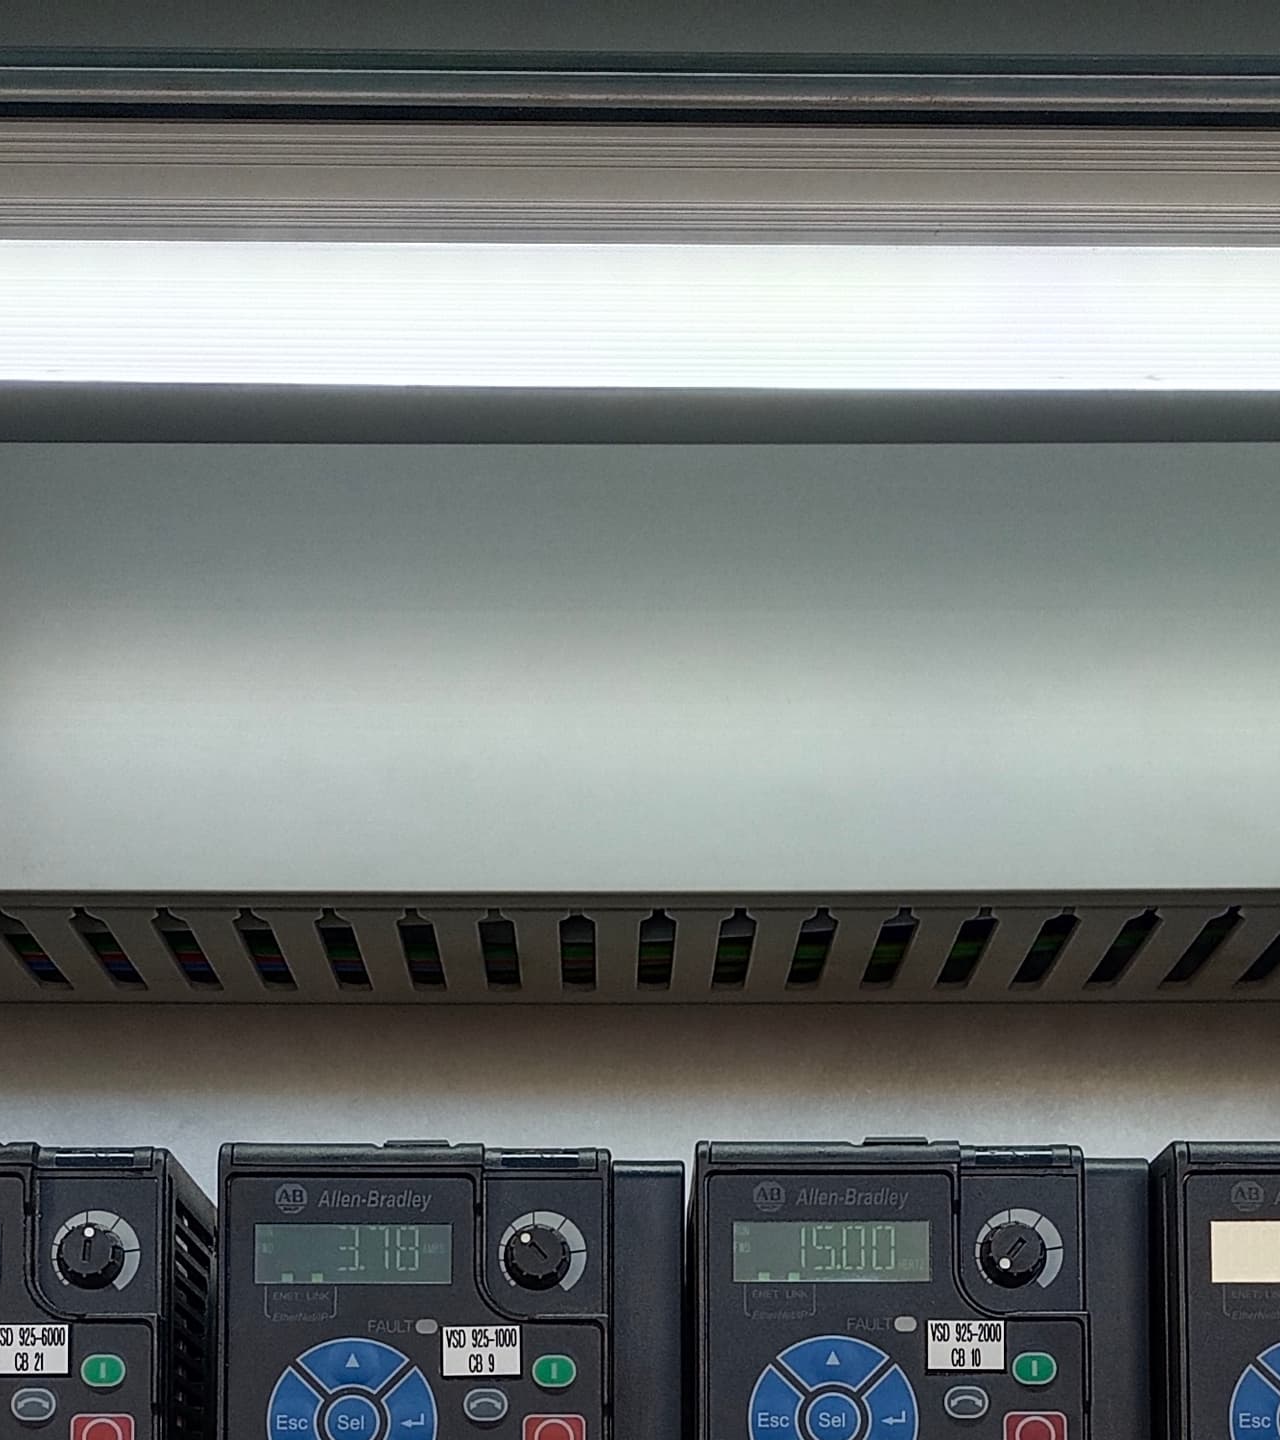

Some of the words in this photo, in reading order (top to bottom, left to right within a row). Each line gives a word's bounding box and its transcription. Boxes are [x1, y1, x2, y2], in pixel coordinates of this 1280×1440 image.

[318, 1190, 431, 1212] Allen-Bradley
[796, 1188, 909, 1209] Allen-Bradley
[800, 1225, 896, 1271] 15.00
[367, 1320, 413, 1333] FAULT
[846, 1317, 892, 1331] FAULT
[930, 1323, 950, 1342] VSD
[955, 1322, 1002, 1342] 925-2000
[19, 1327, 66, 1346] 925-6000
[445, 1330, 466, 1348] VSD
[471, 1329, 517, 1347] 925-1000
[14, 1352, 29, 1372] CB
[34, 1352, 44, 1371] 21
[468, 1354, 484, 1373] CB
[488, 1354, 495, 1373] 9
[951, 1348, 966, 1367] CB
[970, 1348, 981, 1367] 10
[276, 1416, 308, 1430] Esc
[337, 1415, 365, 1430] Sel
[758, 1413, 790, 1428] Esc
[818, 1412, 846, 1428] Sel
[1239, 1413, 1272, 1428] Esc
